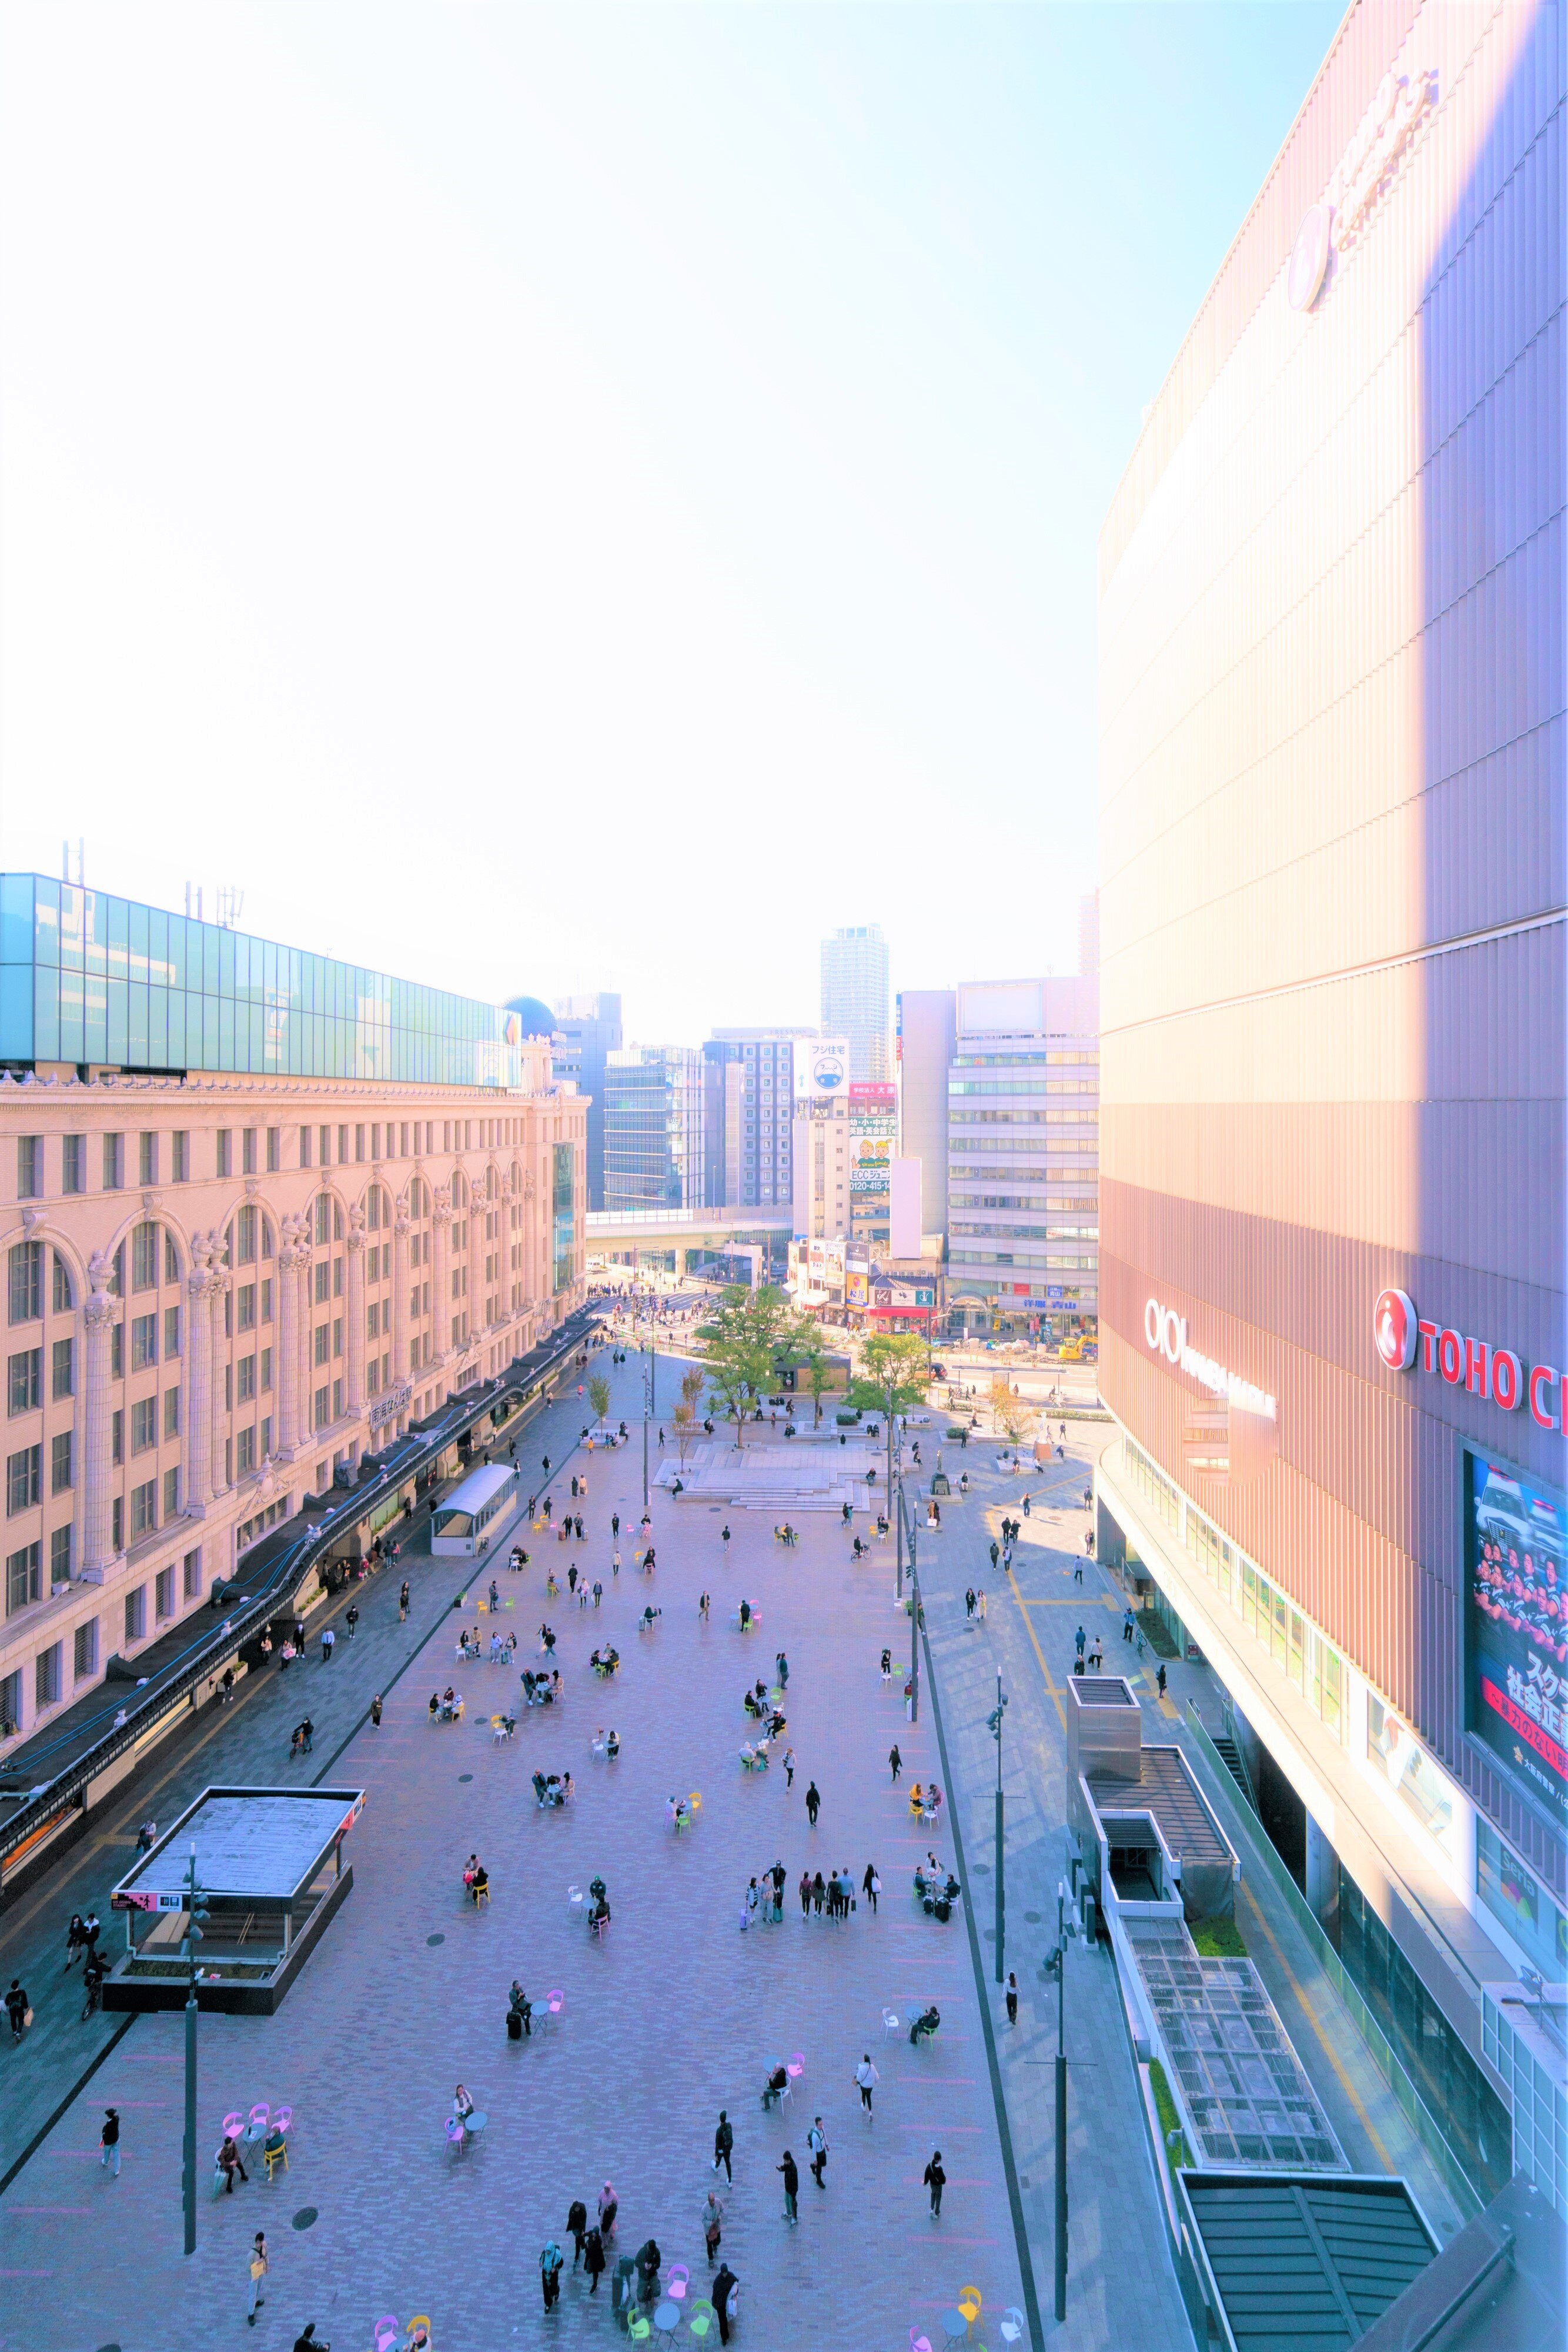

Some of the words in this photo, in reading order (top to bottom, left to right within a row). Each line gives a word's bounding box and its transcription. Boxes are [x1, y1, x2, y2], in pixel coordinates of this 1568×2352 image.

[812, 1045, 845, 1054] フジ住宅
[1419, 1319, 1522, 1410] TOHO
[1503, 1850, 1536, 1897] Seria
